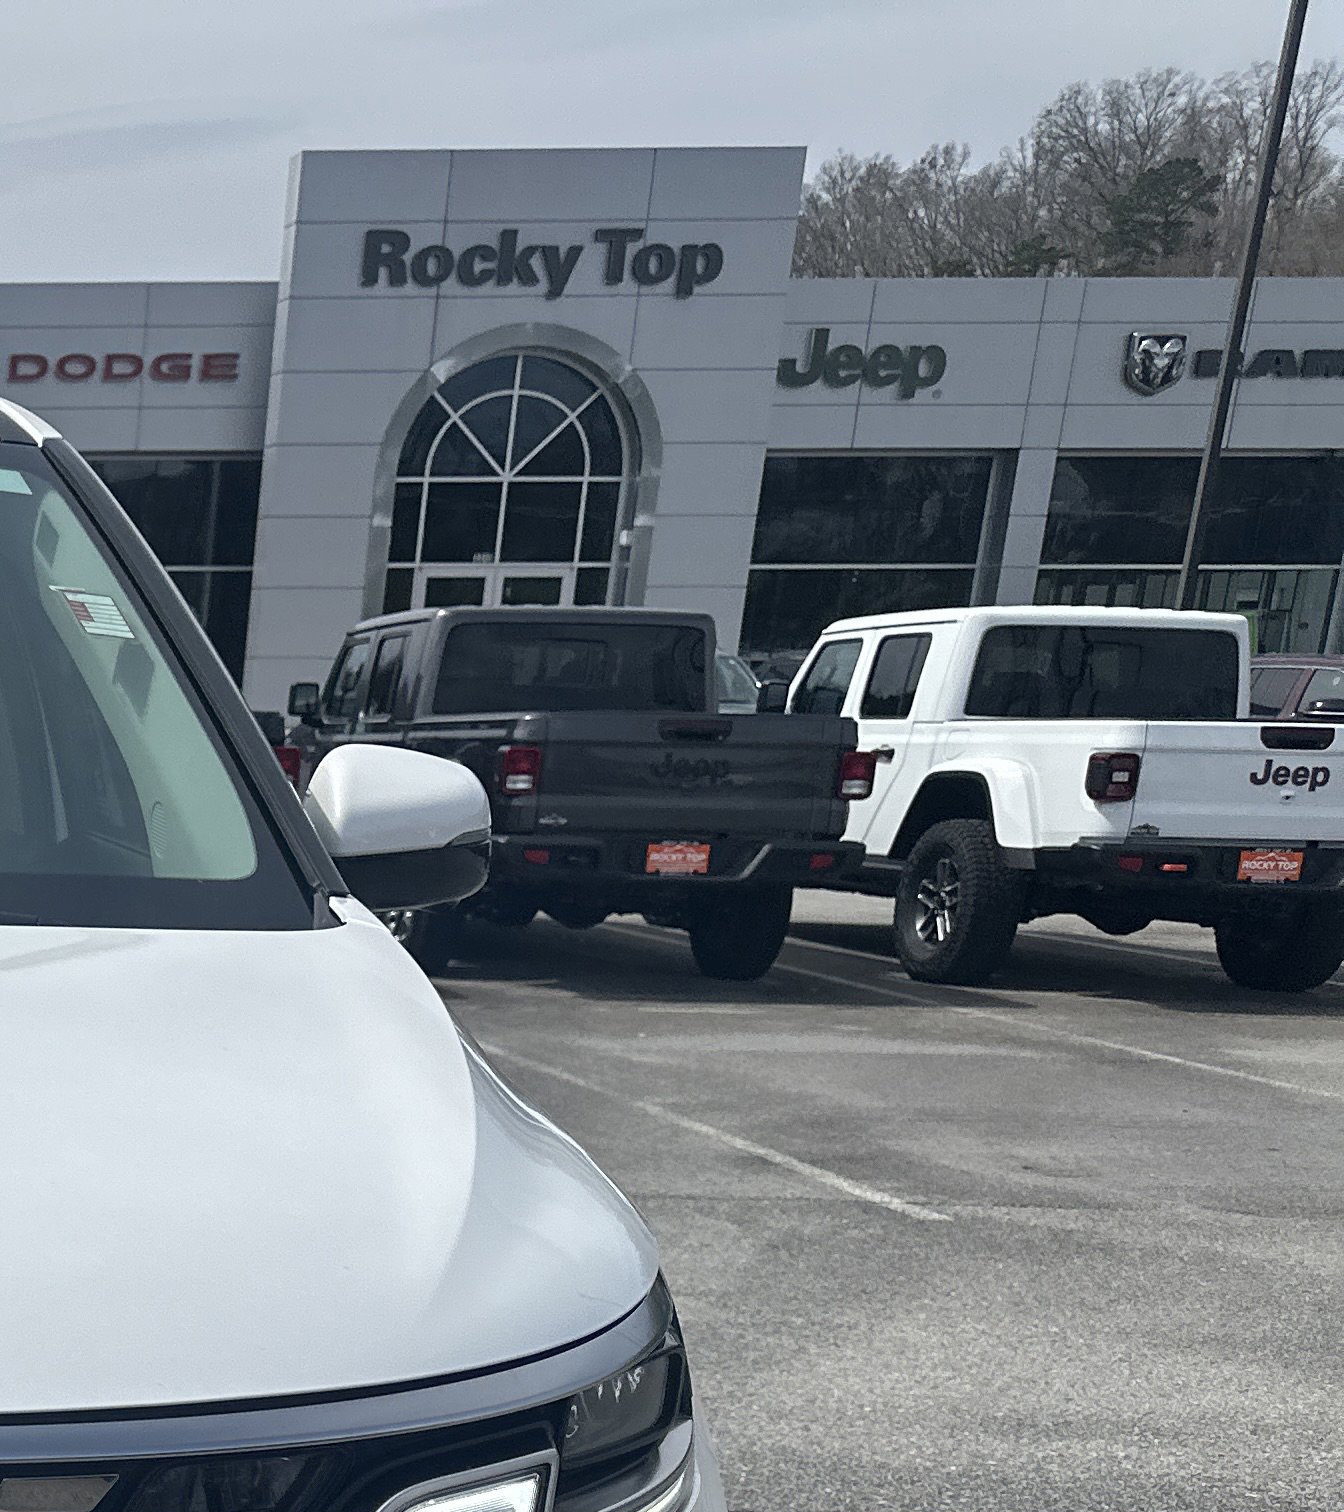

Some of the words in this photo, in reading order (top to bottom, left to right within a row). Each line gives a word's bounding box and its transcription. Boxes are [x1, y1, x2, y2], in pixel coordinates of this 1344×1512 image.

[360, 228, 584, 301] Rocky
[594, 228, 724, 300] Top
[8, 352, 240, 383] DODGE
[776, 327, 947, 401] Jeep
[1249, 759, 1330, 792] Jeep
[1242, 860, 1276, 870] ROCKY
[1277, 861, 1299, 870] TOP
